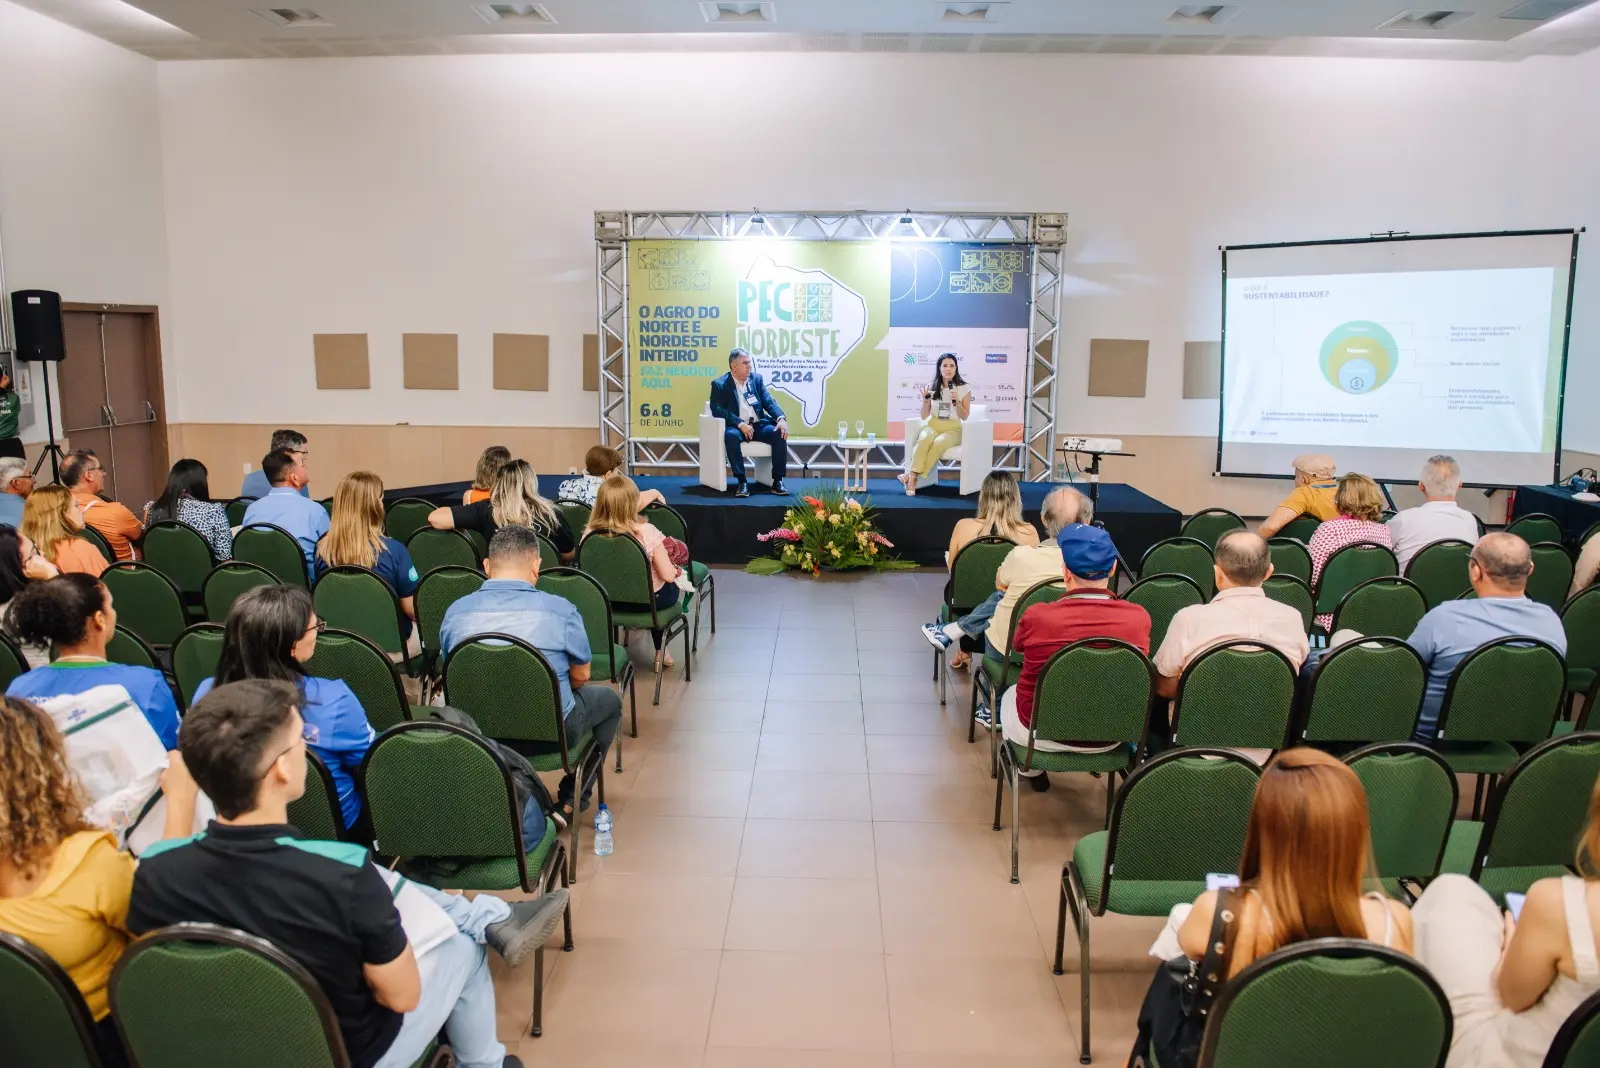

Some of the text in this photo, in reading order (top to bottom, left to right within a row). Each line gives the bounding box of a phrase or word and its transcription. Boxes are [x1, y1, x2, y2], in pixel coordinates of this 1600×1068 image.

[738, 280, 793, 322] PEC
[1243, 290, 1330, 300] SUSTENTABILIDADE?
[639, 305, 720, 319] O AGRO DO
[639, 321, 701, 333] NORTE E
[639, 335, 718, 347] NORDESTE
[737, 327, 841, 358] NORDESTE
[639, 350, 698, 361] INTEIRO
[640, 364, 717, 377] FAZ NEGÓCIO
[771, 370, 813, 382] 2024
[640, 403, 651, 417] 6
[661, 403, 672, 417] 8
[655, 419, 684, 427] JUNHO
